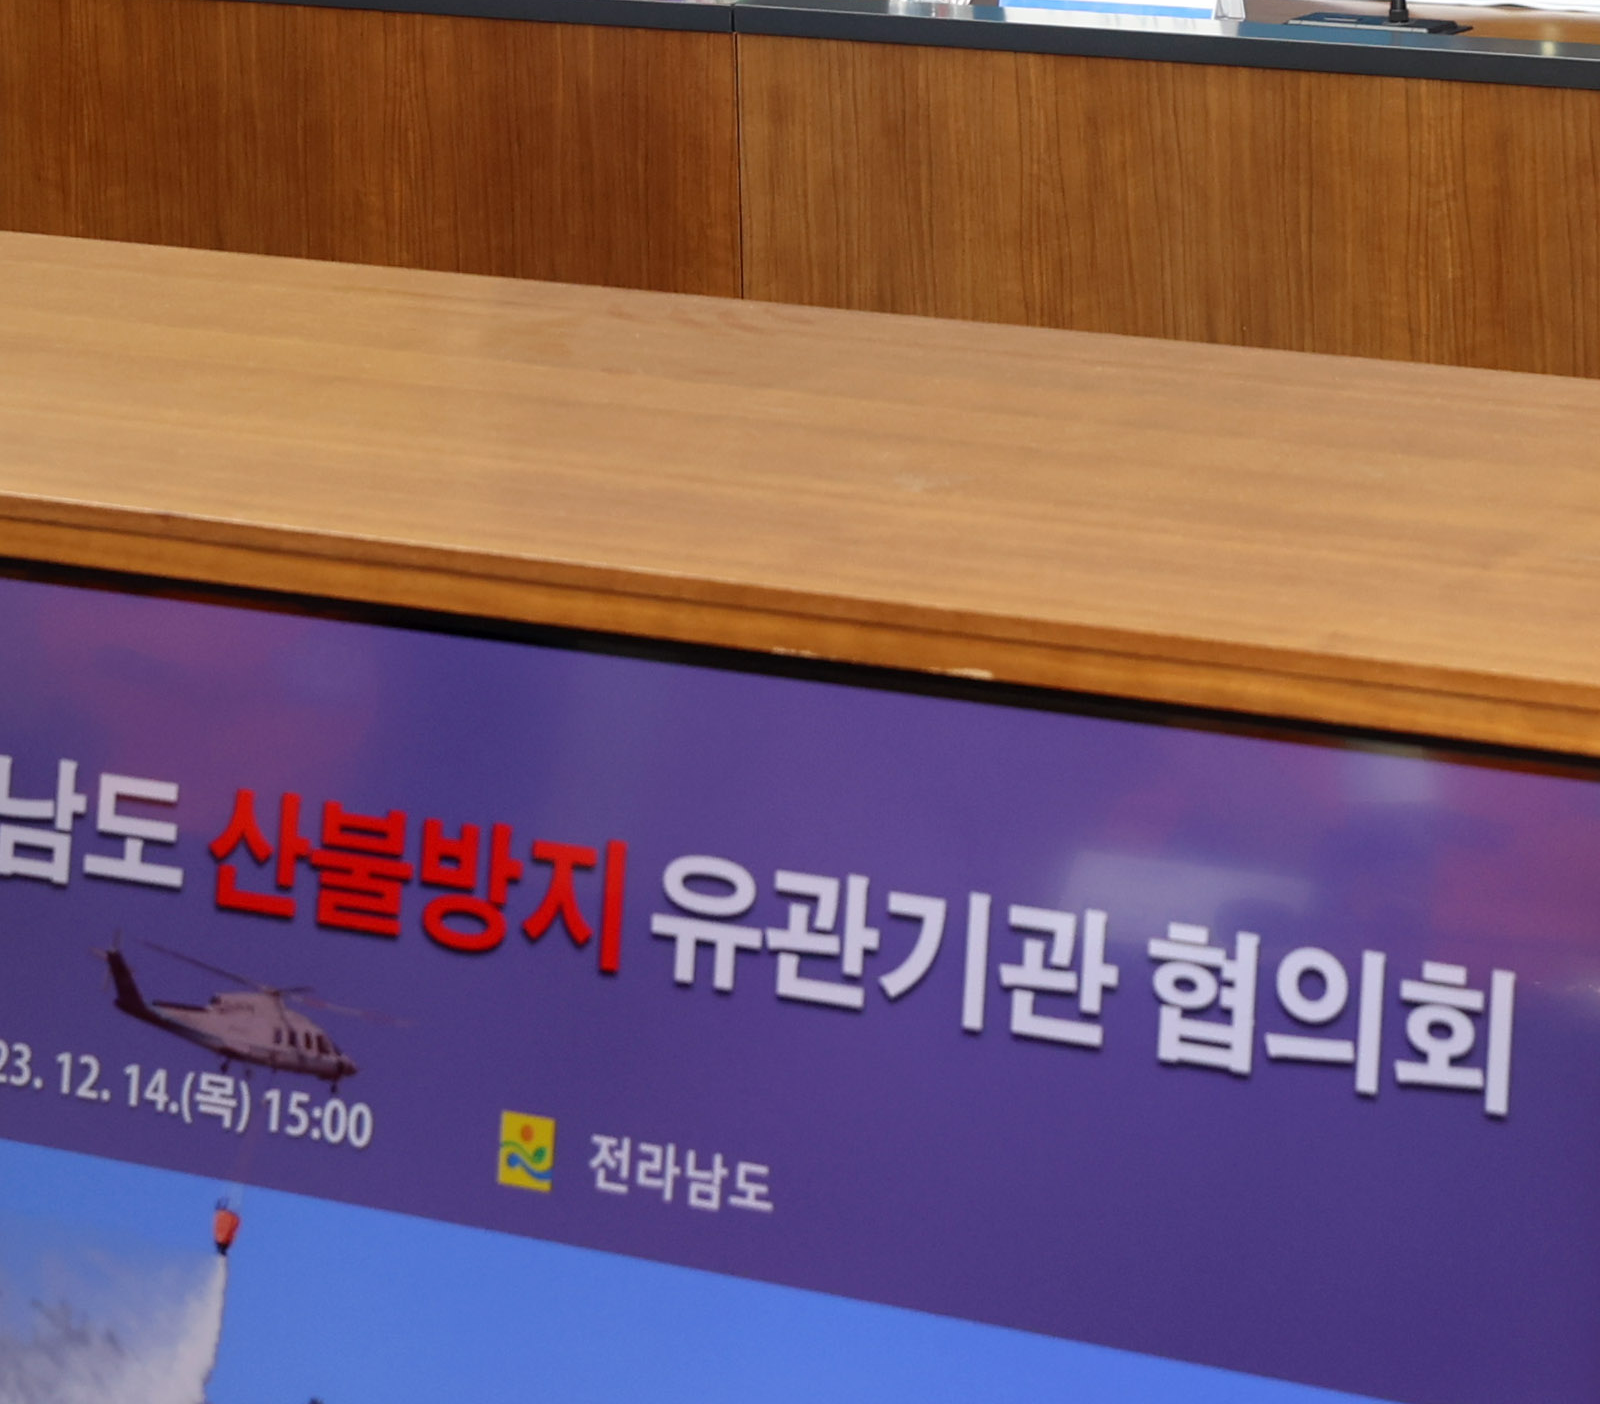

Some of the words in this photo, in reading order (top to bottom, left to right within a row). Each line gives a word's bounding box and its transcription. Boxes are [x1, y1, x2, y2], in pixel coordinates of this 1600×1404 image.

[207, 787, 629, 975] 산불방지
[650, 853, 1120, 1051] 유관기관
[1147, 920, 1517, 1117] 협의회
[56, 1051, 111, 1102] 12.
[263, 1089, 374, 1149] 15:00
[588, 1132, 775, 1214] 전라남도
